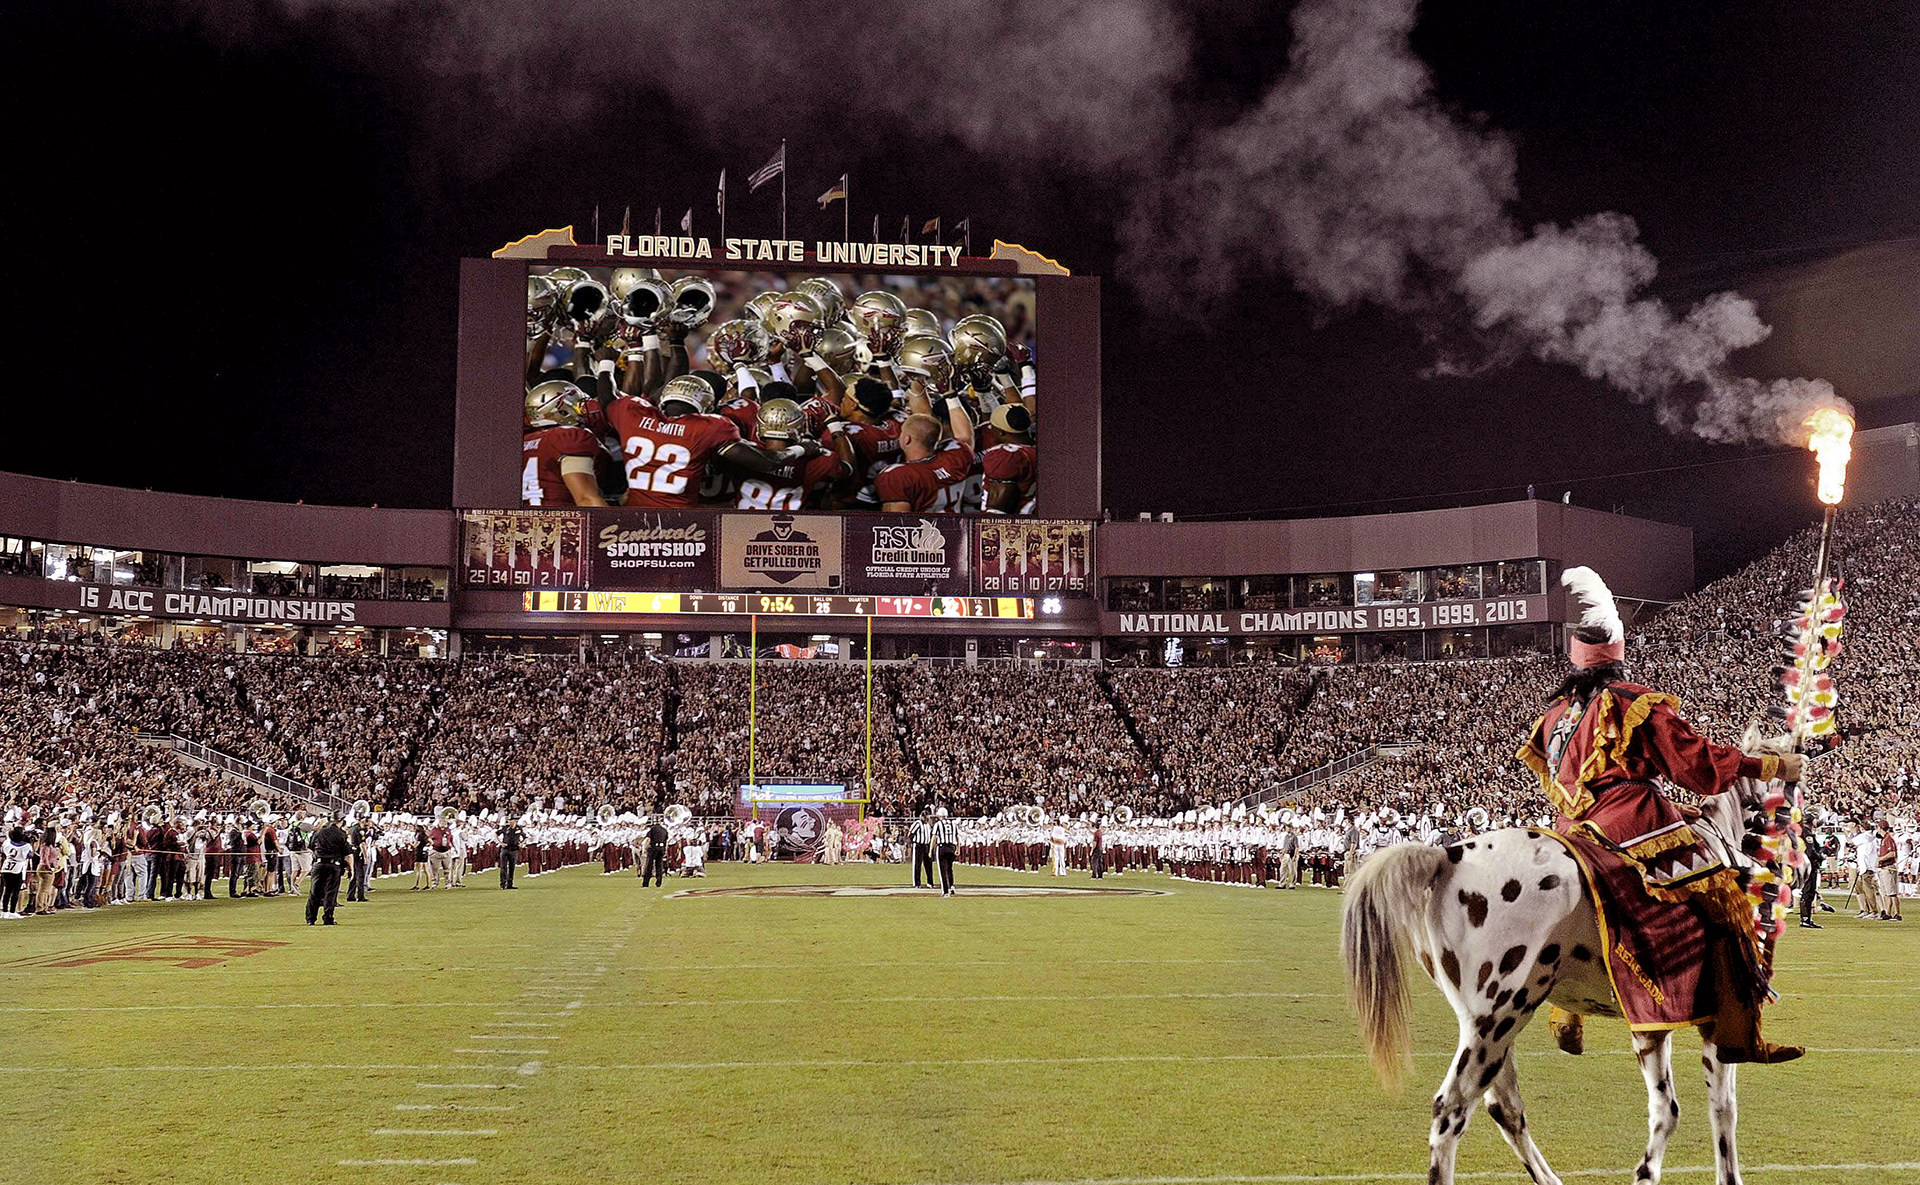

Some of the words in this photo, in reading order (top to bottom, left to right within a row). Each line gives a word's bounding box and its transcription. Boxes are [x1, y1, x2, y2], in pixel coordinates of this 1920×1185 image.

[606, 235, 712, 258] FLORIDA
[725, 238, 804, 262] STATE
[816, 241, 963, 267] UNIVERSITY
[656, 422, 686, 437] SMITH
[624, 436, 691, 495] 22
[598, 522, 706, 549] Seminole
[873, 527, 924, 549] FSU
[606, 542, 706, 557] SPORTSHOP
[746, 545, 773, 555] DRIVE
[774, 545, 805, 556] SOBER
[806, 546, 819, 556] OR
[874, 549, 909, 563] Credit
[911, 550, 943, 563] Union
[610, 560, 695, 568] SHOPFSU.com
[744, 557, 761, 568] GET
[762, 557, 798, 568] PULLED
[798, 557, 821, 568] OVER
[470, 570, 486, 583] 25
[492, 570, 508, 583] 34
[514, 571, 531, 584] 50
[541, 572, 549, 585] 2
[562, 572, 573, 585] 17
[984, 577, 1000, 590] 28
[1008, 577, 1019, 590] 16
[1029, 577, 1040, 590] 10
[1049, 577, 1063, 590] 27
[1070, 577, 1084, 590] 55
[80, 586, 99, 608] 15
[108, 590, 153, 611] ACC
[165, 594, 356, 621] CHAMPIONSHIPS
[574, 598, 581, 611] 2
[651, 595, 661, 611] 6
[692, 600, 699, 612] 1
[721, 600, 736, 612] 10
[760, 597, 794, 612] 9:54
[816, 602, 831, 614] 25
[855, 602, 863, 614] 4
[893, 598, 913, 614] 17
[974, 604, 983, 616] 2
[1120, 614, 1229, 633] NATIONAL
[1240, 610, 1368, 632] CHAMPIONS
[1377, 607, 1426, 629] 1993,
[1432, 604, 1480, 626] 1999,
[1485, 600, 1527, 622] 2013
[5, 862, 17, 870] 37
[1615, 942, 1665, 1005] RENEGADE
